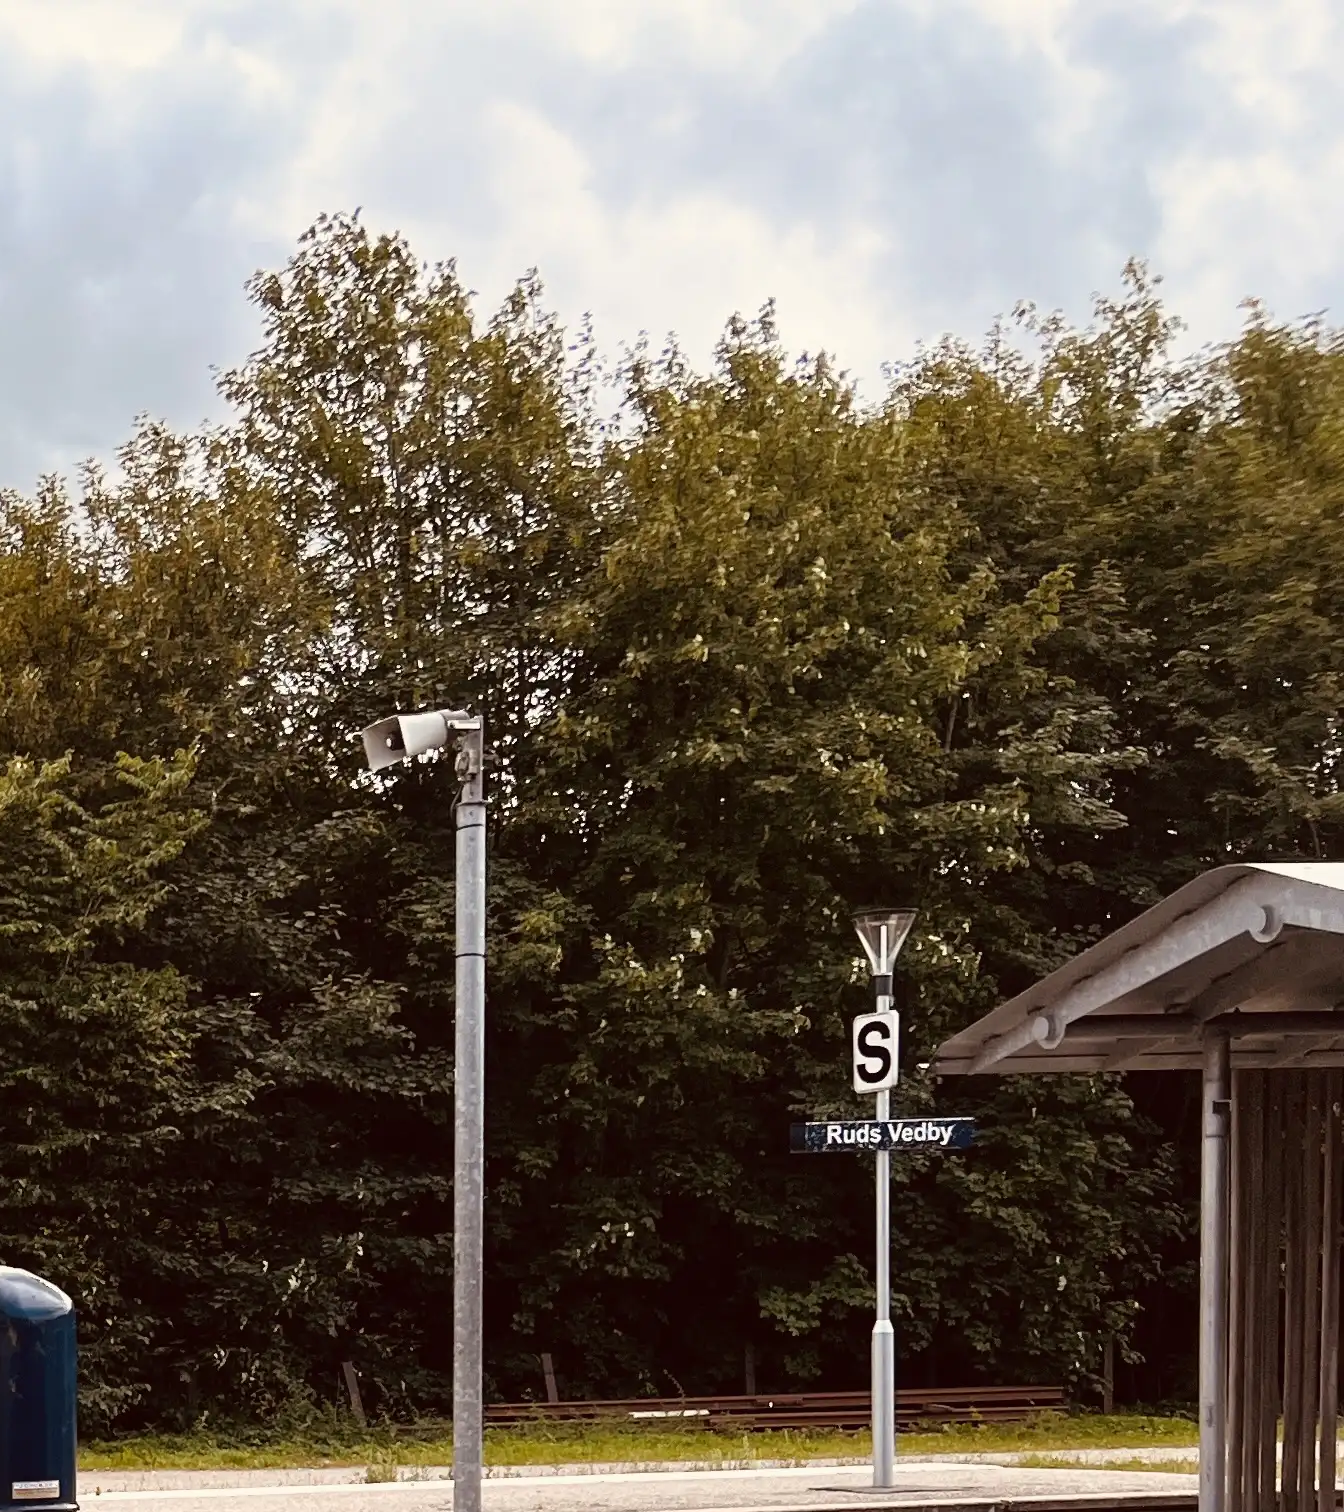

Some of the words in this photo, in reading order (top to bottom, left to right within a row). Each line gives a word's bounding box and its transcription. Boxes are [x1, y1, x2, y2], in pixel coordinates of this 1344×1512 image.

[856, 1020, 892, 1084] S
[826, 1124, 882, 1144] Ruds
[886, 1122, 957, 1146] Vedby
